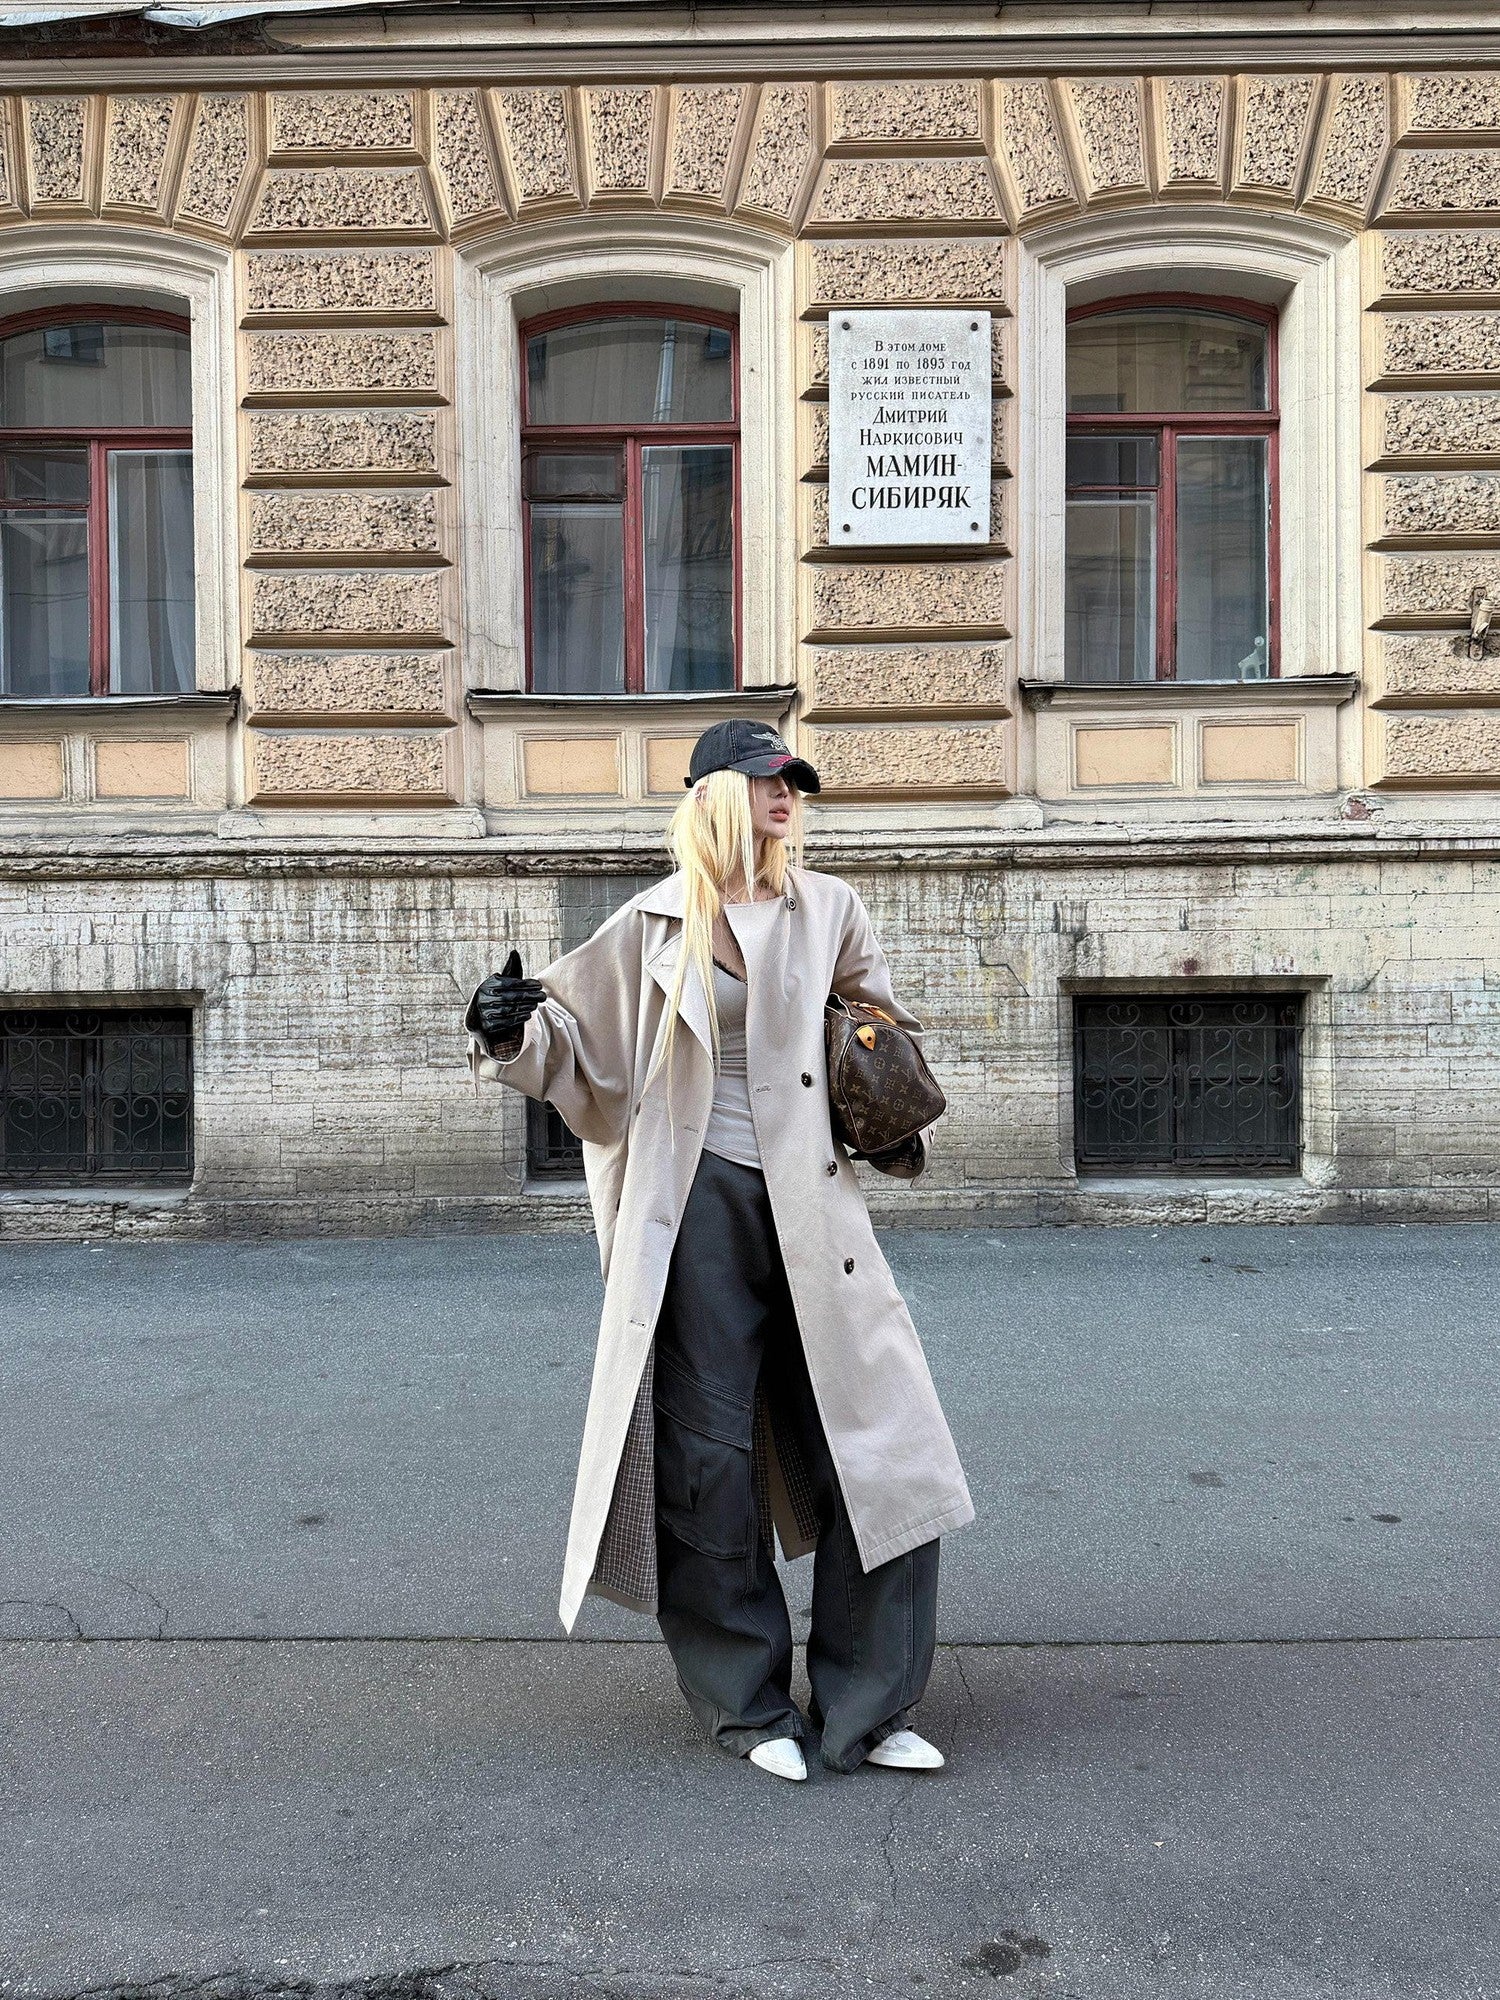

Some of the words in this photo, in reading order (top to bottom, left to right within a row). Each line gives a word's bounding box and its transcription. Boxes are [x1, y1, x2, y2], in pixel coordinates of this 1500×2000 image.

[863, 357, 889, 370] 1891
[917, 357, 945, 371] 1893
[866, 454, 963, 478] МАМИН-
[851, 486, 972, 510] СИБИРЯК
